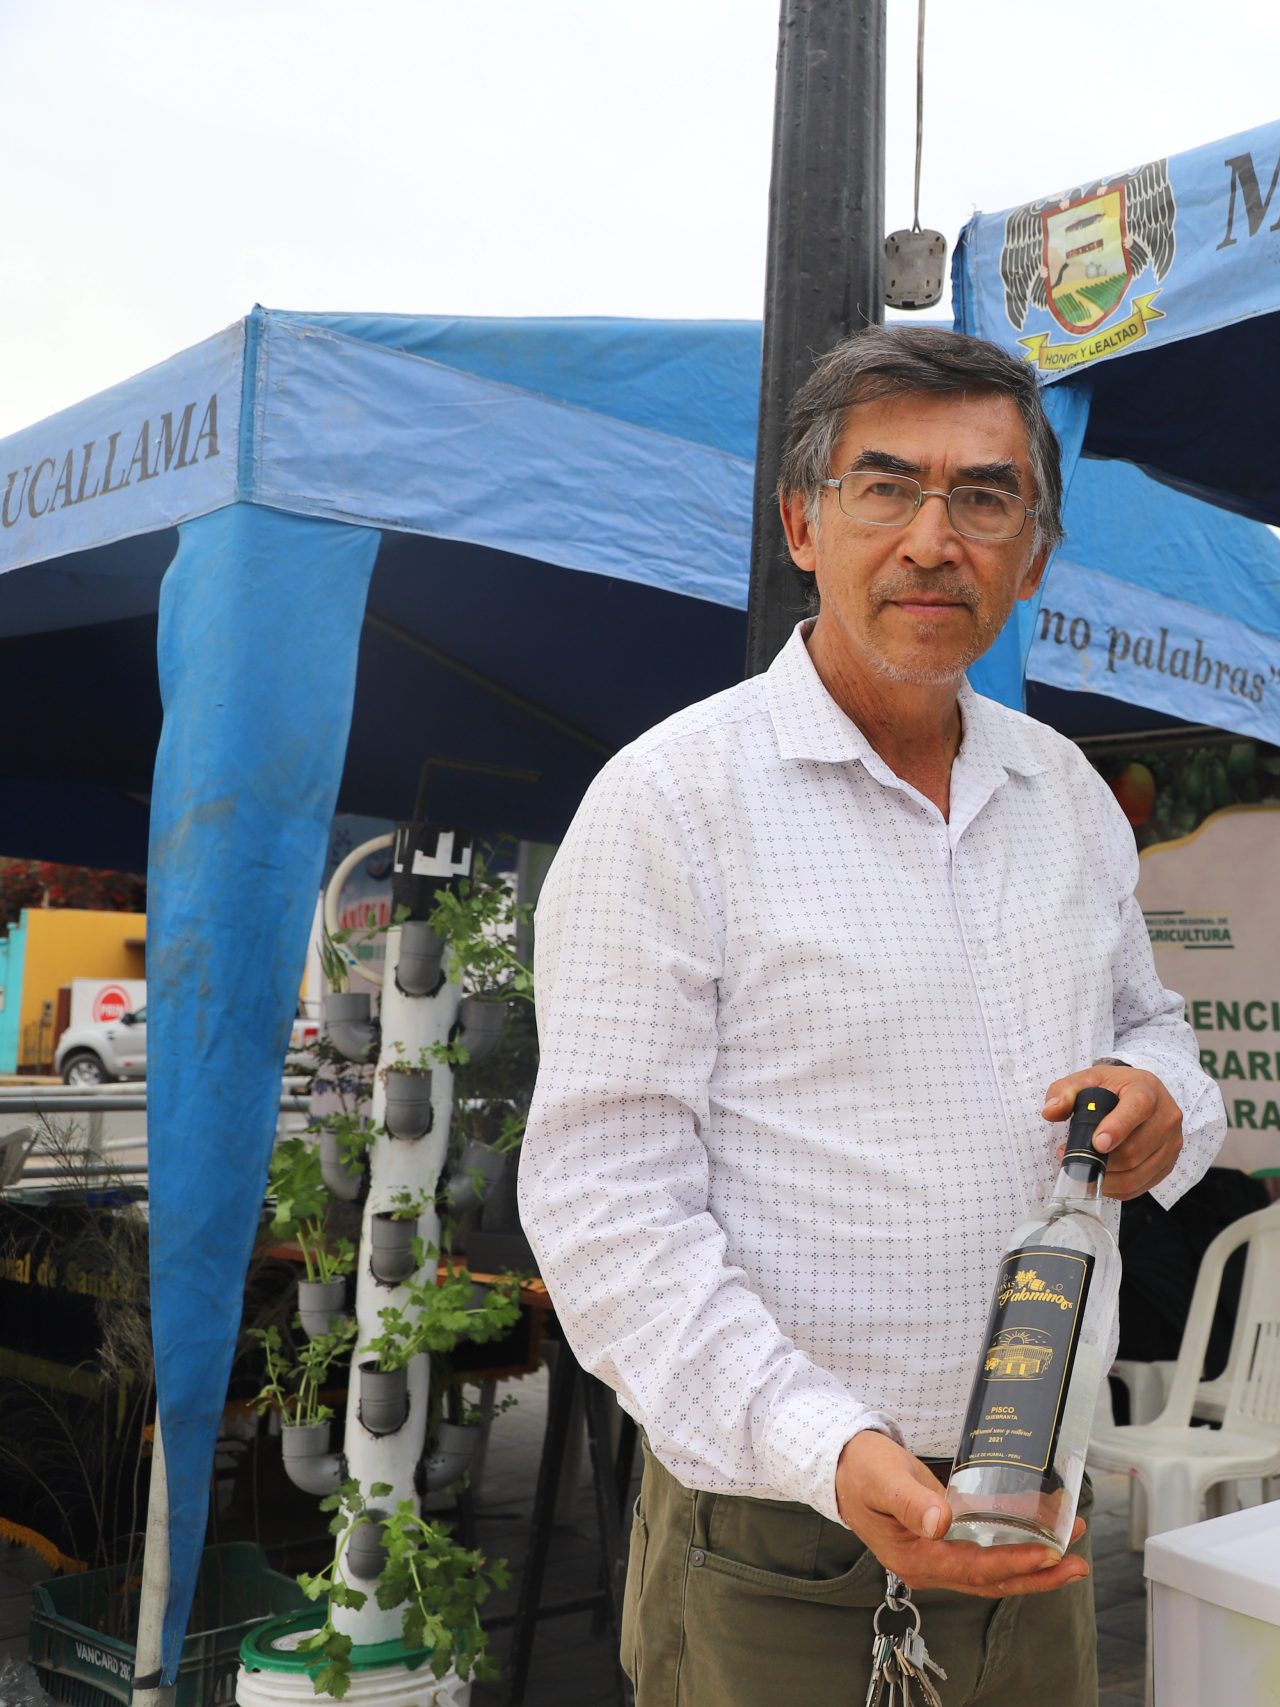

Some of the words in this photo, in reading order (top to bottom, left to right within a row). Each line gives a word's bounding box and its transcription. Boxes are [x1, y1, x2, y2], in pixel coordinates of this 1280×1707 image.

[1089, 323, 1139, 356] LEALTAD
[998, 1287, 1074, 1310] Palomino
[990, 1406, 1015, 1414] PISCO
